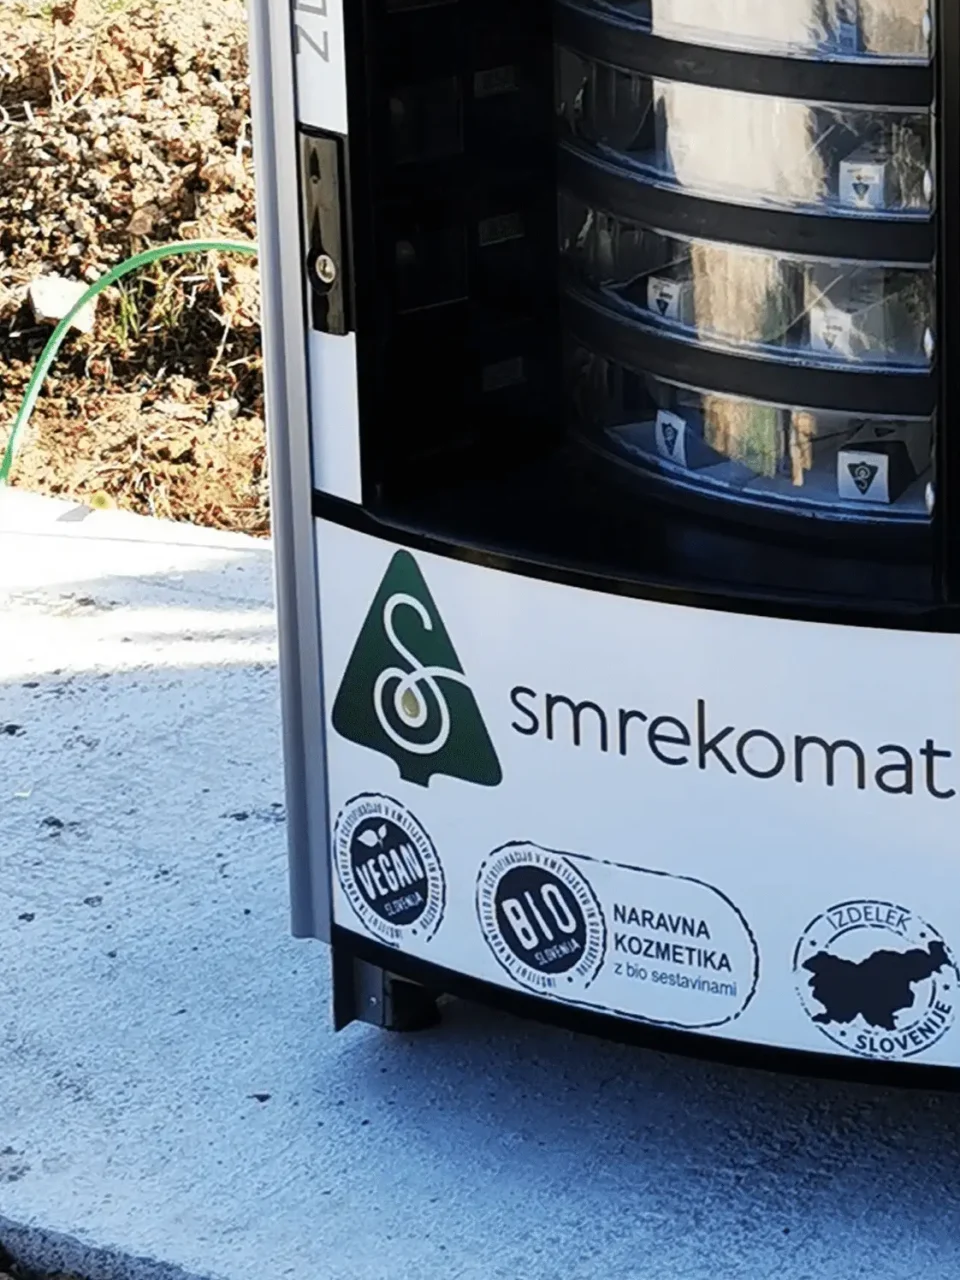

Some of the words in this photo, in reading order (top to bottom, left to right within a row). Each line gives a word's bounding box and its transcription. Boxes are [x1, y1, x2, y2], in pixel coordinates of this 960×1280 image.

[510, 685, 956, 800] smrekomat
[356, 842, 424, 901] VEGAN
[502, 883, 577, 950] BIO
[613, 903, 711, 940] NARAVNA
[826, 905, 912, 933] IZDELEK
[534, 938, 582, 966] SLOVENIJA
[614, 933, 732, 972] KOZMETIKA
[614, 963, 623, 975] z
[626, 962, 648, 980] bio
[651, 970, 737, 997] sestavinami
[855, 1000, 952, 1053] SLOVENIJE
